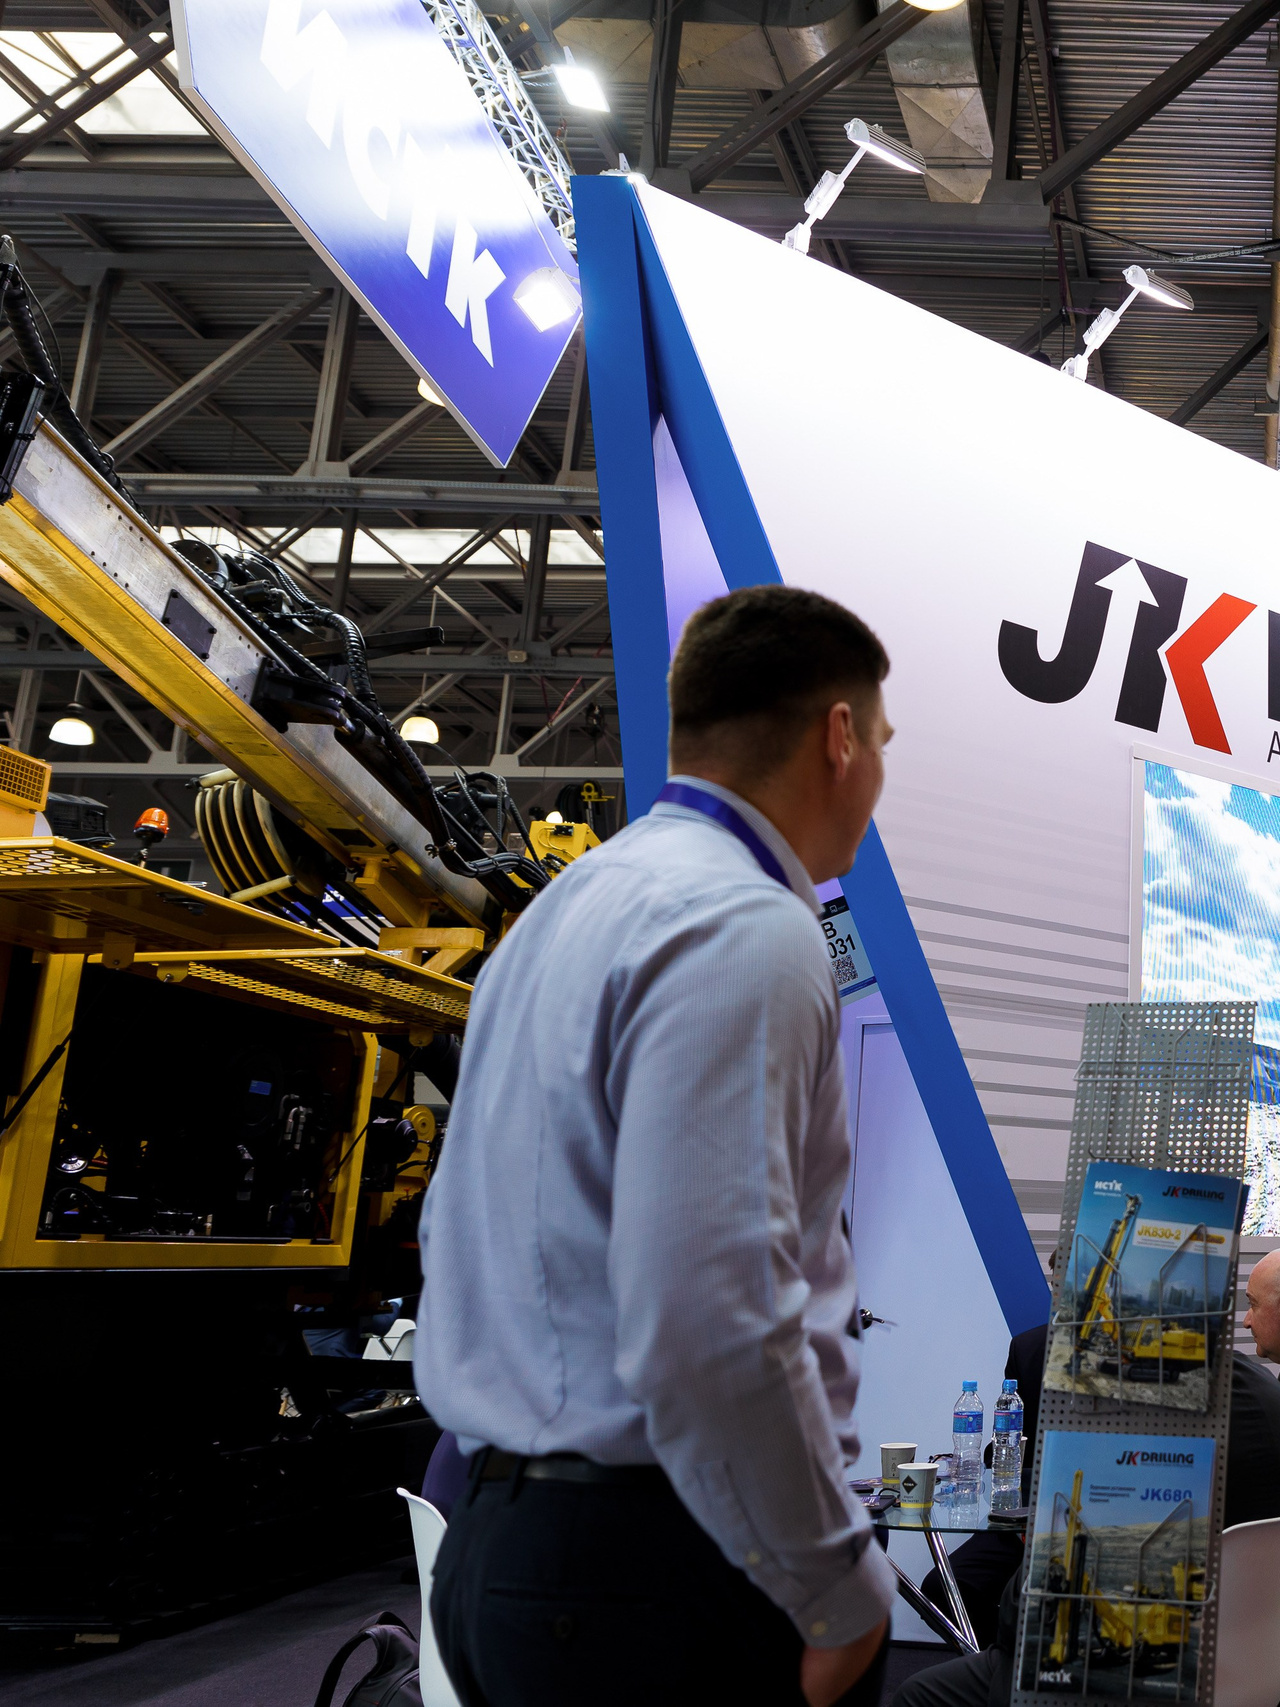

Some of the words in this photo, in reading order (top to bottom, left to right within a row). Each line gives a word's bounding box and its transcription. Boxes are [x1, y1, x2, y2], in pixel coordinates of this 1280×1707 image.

[997, 540, 1258, 755] JK
[821, 921, 838, 940] B
[1162, 1185, 1182, 1198] JK
[1182, 1188, 1225, 1200] DRILLING
[1137, 1224, 1182, 1240] JK830-2
[1116, 1450, 1140, 1466] JK
[1140, 1451, 1194, 1465] DRILLING
[1140, 1488, 1193, 1502] JK680
